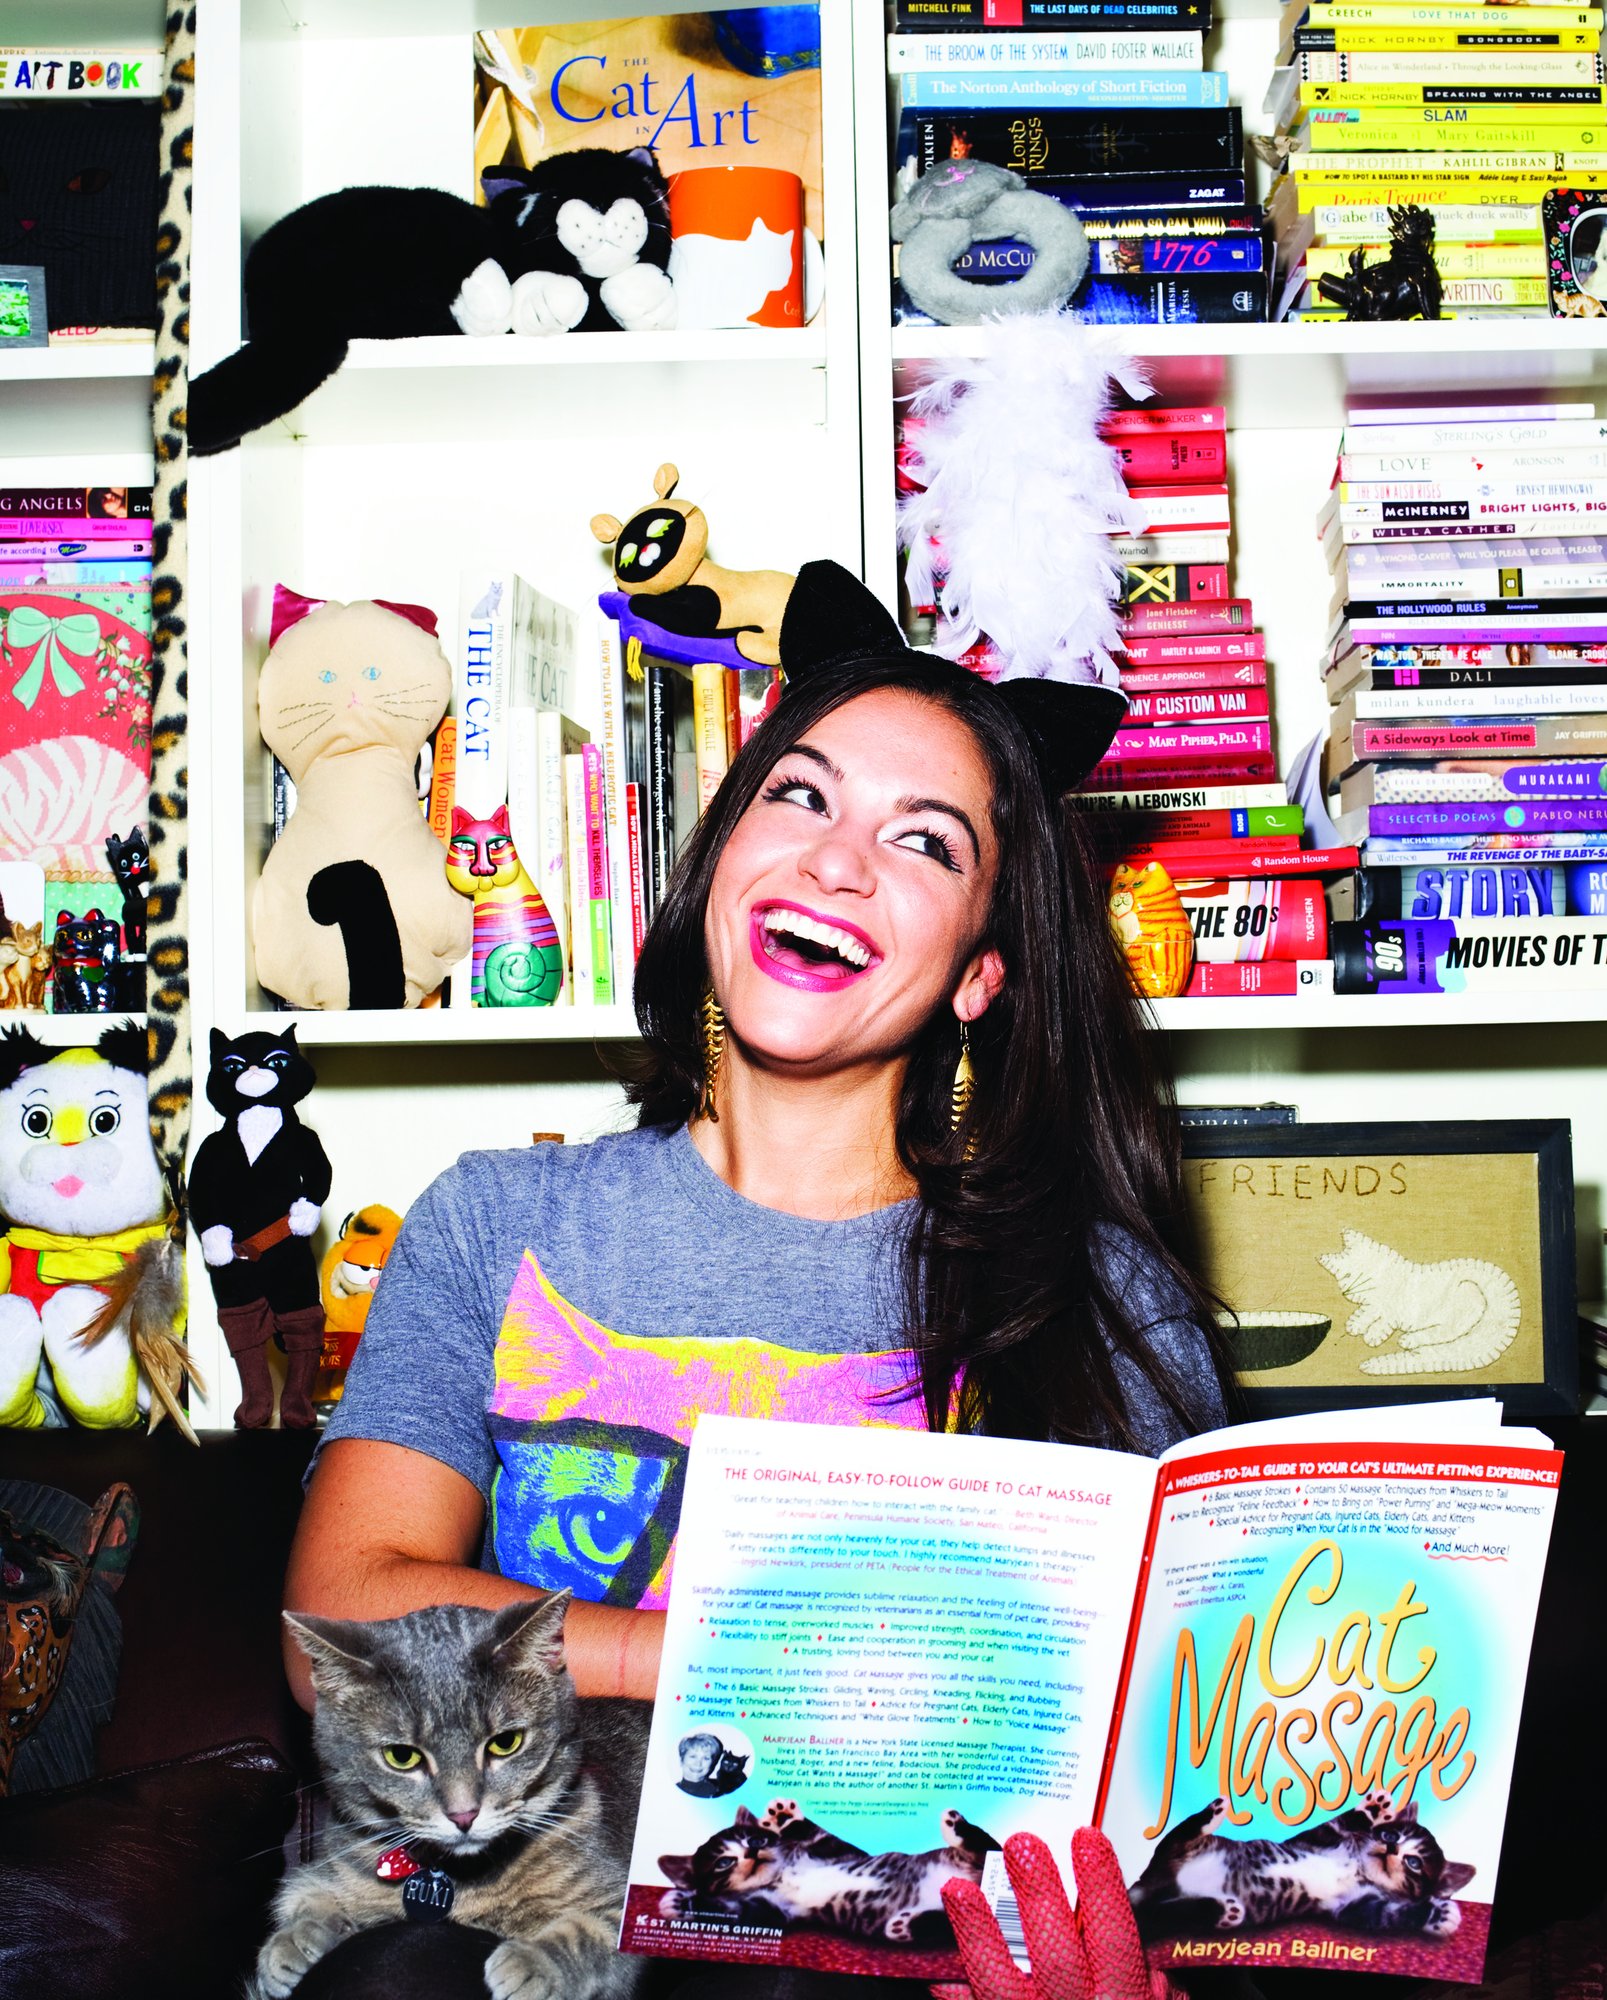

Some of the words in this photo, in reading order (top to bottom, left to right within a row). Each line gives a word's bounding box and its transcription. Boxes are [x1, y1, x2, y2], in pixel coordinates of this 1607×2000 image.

[908, 4, 949, 13] MITCHELL
[952, 4, 971, 13] FINK
[1030, 4, 1044, 14] THE
[1046, 4, 1066, 14] LAST
[1068, 4, 1088, 14] DAYS
[1090, 4, 1101, 14] OF
[1104, 4, 1124, 14] DEAD
[1127, 5, 1178, 15] CELEBRITIES
[1328, 9, 1372, 17] CREECH
[1449, 11, 1475, 20] THAT
[1483, 12, 1508, 20] DOG
[925, 45, 942, 61] THE
[949, 45, 987, 61] BROOM
[991, 45, 1003, 60] OF
[1009, 45, 1026, 60] THE
[1033, 44, 1068, 60] SYSTEM
[1077, 44, 1106, 59] DAVID
[1112, 43, 1146, 59] FOSTER
[1153, 43, 1194, 59] WALLACE
[623, 57, 649, 67] THE
[14, 60, 62, 90] ART
[68, 61, 142, 89] BOOK
[551, 56, 659, 122] Cat
[931, 81, 956, 94] The
[960, 81, 1007, 94] Norton
[1011, 80, 1080, 97] Anthology
[1083, 80, 1097, 93] of
[1100, 80, 1135, 93] Short
[1139, 80, 1186, 93] Fiction
[648, 73, 760, 150] Art
[1424, 110, 1467, 121] SLAM
[636, 126, 650, 134] IN
[1008, 120, 1025, 170] LORD
[1029, 117, 1049, 171] RINGS
[1444, 159, 1492, 167] KAHLIL
[1496, 158, 1546, 166] GIBRAN
[1190, 188, 1225, 198] ZAGAT
[1480, 195, 1518, 204] DYER
[1153, 240, 1217, 272] 1776
[1380, 457, 1432, 472] LOVE
[19, 497, 82, 510] ANGELS
[1385, 504, 1467, 517] McINERNEY
[1480, 503, 1525, 513] BRIGHT
[1532, 502, 1579, 513] LIGHTS,
[1585, 503, 1607, 511] BIG
[1375, 526, 1431, 537] WILLA
[1442, 524, 1514, 535] CATHER
[1376, 606, 1394, 615] THE
[1397, 604, 1453, 614] HOLLYWOOD
[1457, 603, 1486, 613] RULES
[1506, 603, 1538, 611] Anonymous
[467, 622, 493, 688] THE
[1450, 671, 1492, 682] DALI
[1130, 696, 1151, 716] MY
[1156, 694, 1215, 715] CUSTOM
[1219, 693, 1246, 712] VAN
[465, 700, 491, 761] CAT
[1370, 735, 1379, 744] A
[1384, 732, 1445, 746] Sideways
[1449, 732, 1479, 743] Look
[1484, 733, 1496, 742] at
[1501, 731, 1530, 742] Time
[441, 727, 456, 766] Cat
[588, 752, 596, 771] PETS
[589, 774, 598, 793] WHO
[1519, 774, 1590, 785] MURAKAMI
[434, 771, 455, 838] Women
[590, 794, 598, 816] WANT
[1121, 795, 1129, 809] A
[1136, 792, 1206, 808] LEBOWSKI
[590, 818, 599, 829] TO
[1236, 813, 1244, 832] ROSS
[1389, 814, 1448, 824] SELECTED
[1454, 813, 1496, 823] POEMS
[1533, 810, 1572, 820] PABLO
[592, 830, 600, 846] KILL
[1264, 855, 1299, 866] Random
[1302, 854, 1329, 865] House
[1447, 852, 1468, 861] THE
[1470, 851, 1521, 860] REVENGE
[1523, 850, 1538, 859] OF
[1540, 850, 1561, 859] THE
[593, 849, 602, 896] THEMSELVES
[1412, 869, 1553, 919] STORY
[1188, 906, 1228, 938] THE
[1233, 905, 1279, 936] 80s
[1306, 897, 1314, 942] TASCHEN
[1374, 936, 1403, 973] 90s
[1446, 936, 1547, 968] MOVIES
[1554, 935, 1588, 965] OF
[1199, 1162, 1408, 1199] FRIENDS
[1166, 1481, 1173, 1491] A
[1176, 1465, 1260, 1489] WHISKERS-TO-TAIL
[1263, 1463, 1297, 1475] GUIDE
[1300, 1462, 1314, 1474] TO
[1318, 1462, 1348, 1474] YOUR
[1351, 1462, 1380, 1473] CAT'S
[1383, 1462, 1434, 1475] ULTIMATE
[1437, 1464, 1483, 1477] PETTING
[1486, 1466, 1558, 1483] EXPERIENCE!
[724, 1467, 749, 1481] THE
[754, 1469, 822, 1485] ORIGINAL,
[827, 1470, 944, 1489] EASY-TO-FOLLOW
[949, 1478, 989, 1492] GUIDE
[996, 1481, 1013, 1494] TO
[1019, 1484, 1042, 1497] CAT
[1047, 1489, 1113, 1506] MASSAGE
[1432, 1542, 1451, 1552] And
[1454, 1542, 1479, 1554] Much
[1481, 1544, 1510, 1555] More!
[1258, 1539, 1437, 1696] Cat
[802, 1648, 832, 1656] trusting,
[837, 1648, 860, 1657] loving
[864, 1649, 885, 1657] bond
[888, 1650, 922, 1659] between
[926, 1652, 940, 1660] you
[943, 1652, 958, 1660] and
[961, 1653, 979, 1662] your
[982, 1654, 994, 1663] cat
[1144, 1613, 1477, 1840] Massage
[407, 1880, 450, 1908] RUKI
[650, 1919, 667, 1927] ST.
[670, 1921, 729, 1933] MARTIN'S
[733, 1925, 783, 1937] GRIFFIN
[1172, 1940, 1282, 1962] Maryjean
[1291, 1940, 1377, 1962] Ballner
